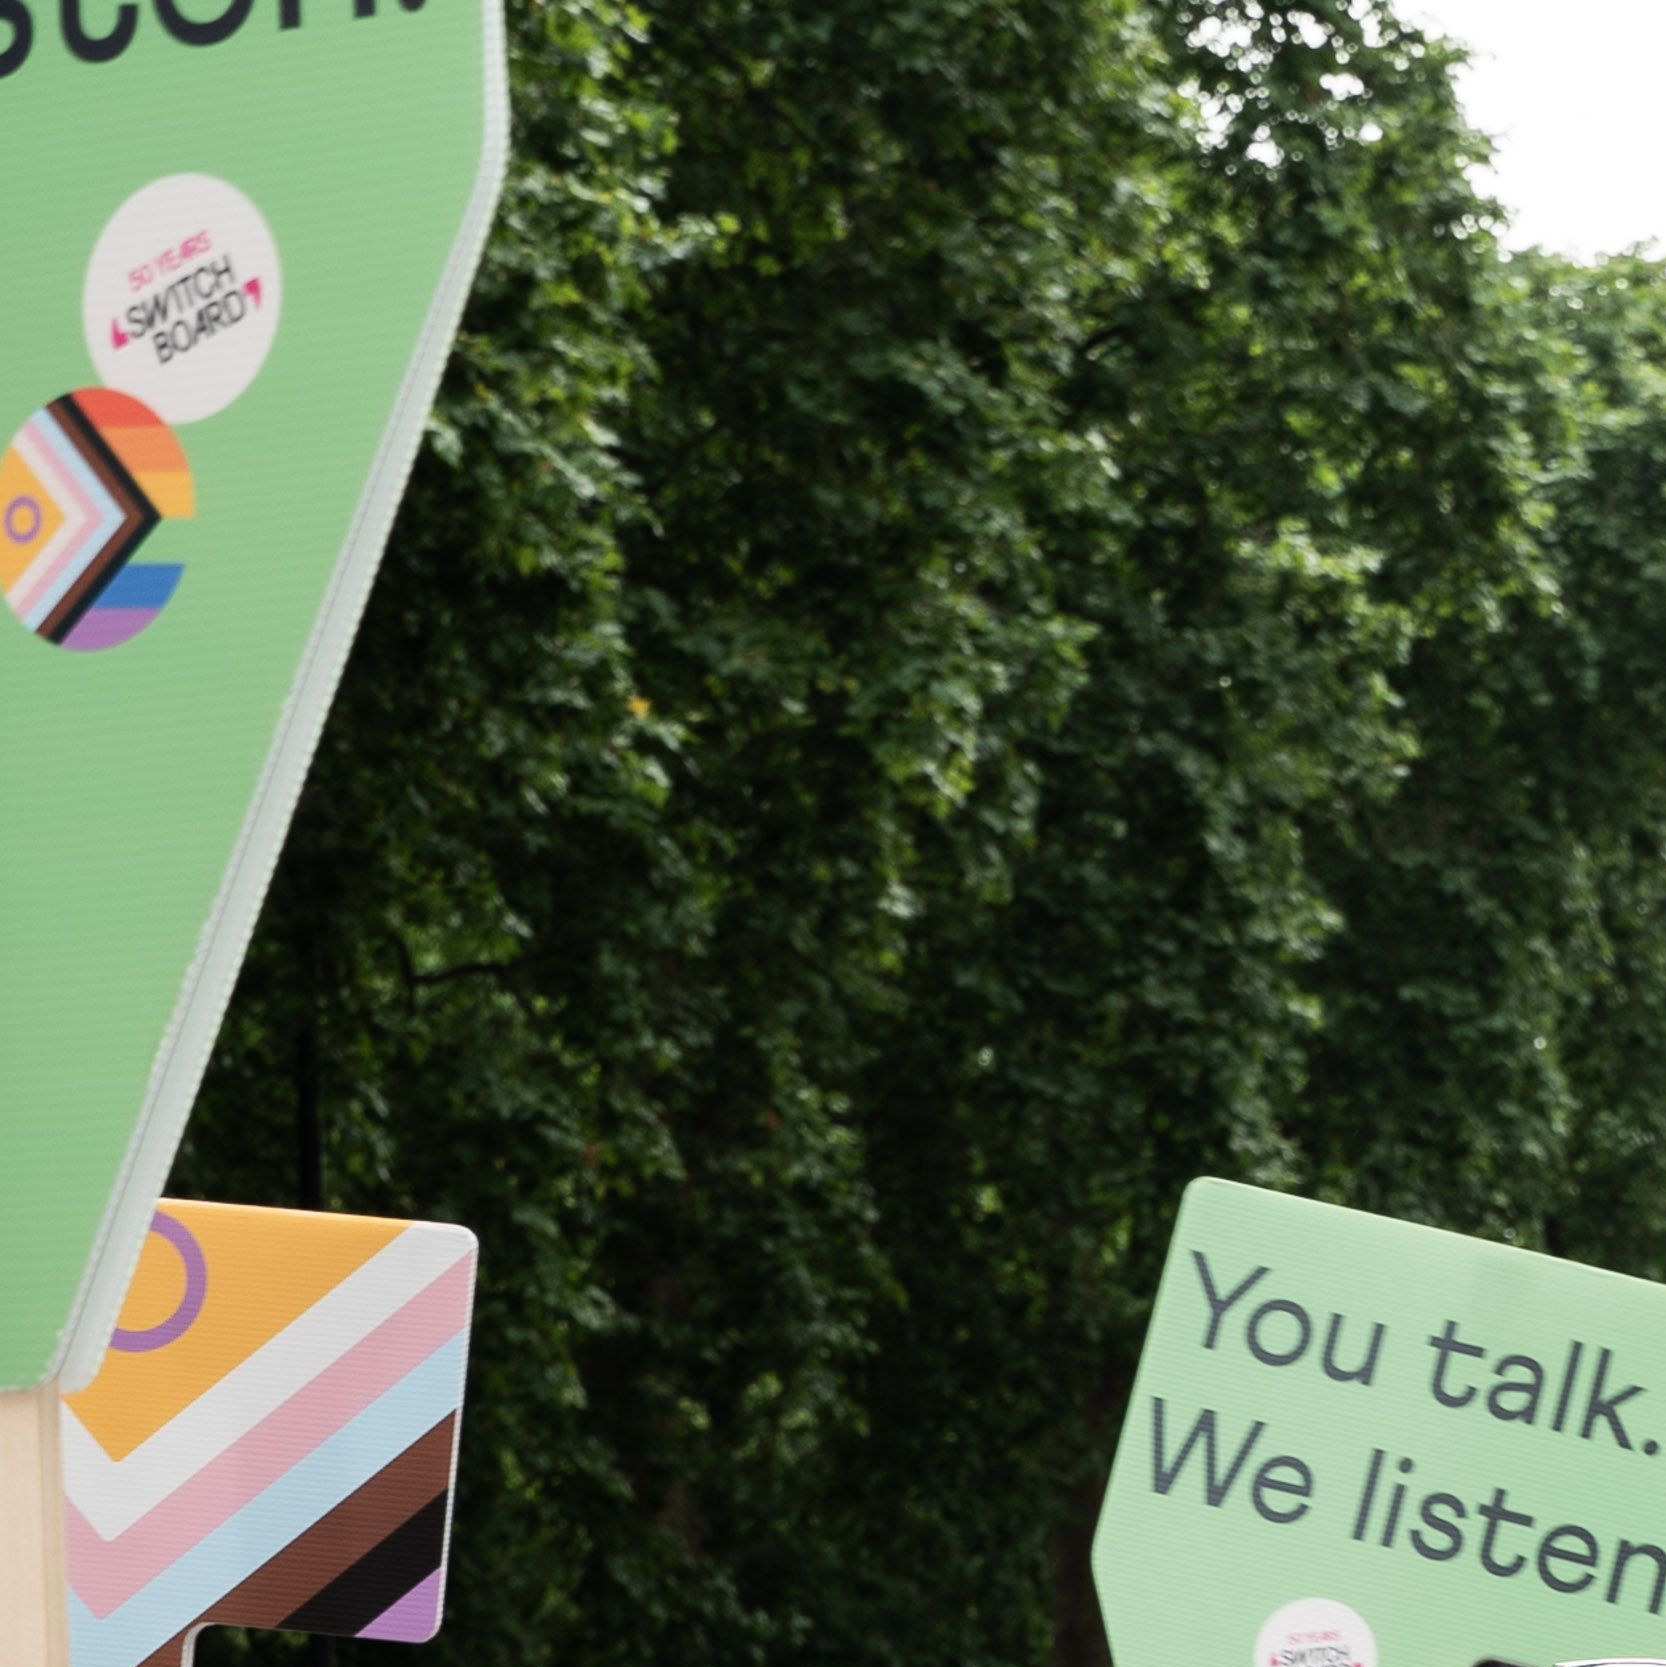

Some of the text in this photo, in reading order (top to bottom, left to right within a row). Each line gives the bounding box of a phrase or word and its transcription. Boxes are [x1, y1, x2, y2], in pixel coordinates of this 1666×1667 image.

[126, 253, 235, 338] SWITCH
[153, 289, 246, 364] BOARD
[1191, 1251, 1661, 1457] You talk.
[1148, 1397, 1314, 1524] We
